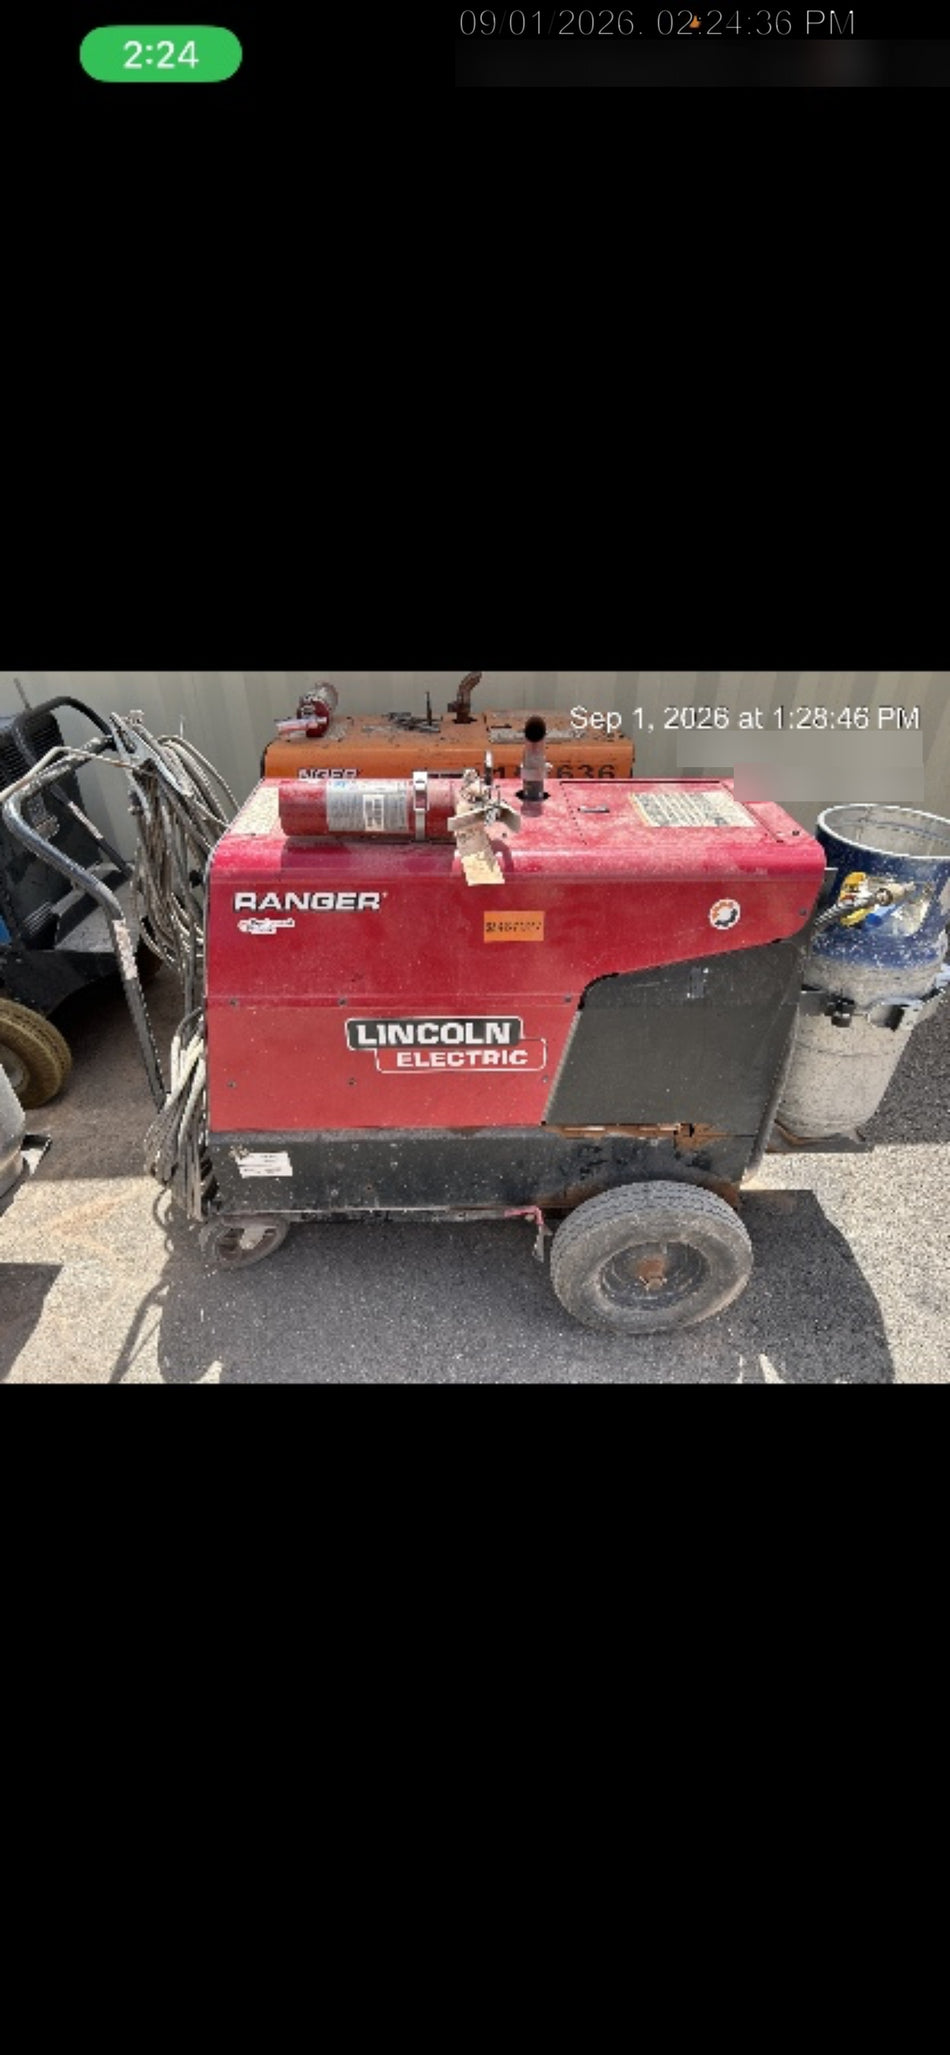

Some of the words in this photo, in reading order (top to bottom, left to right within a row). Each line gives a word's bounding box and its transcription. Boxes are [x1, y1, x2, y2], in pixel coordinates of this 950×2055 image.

[234, 891, 381, 912] RANGER
[357, 1021, 511, 1046] LINCOLN
[396, 1049, 529, 1068] ELECTRIC
